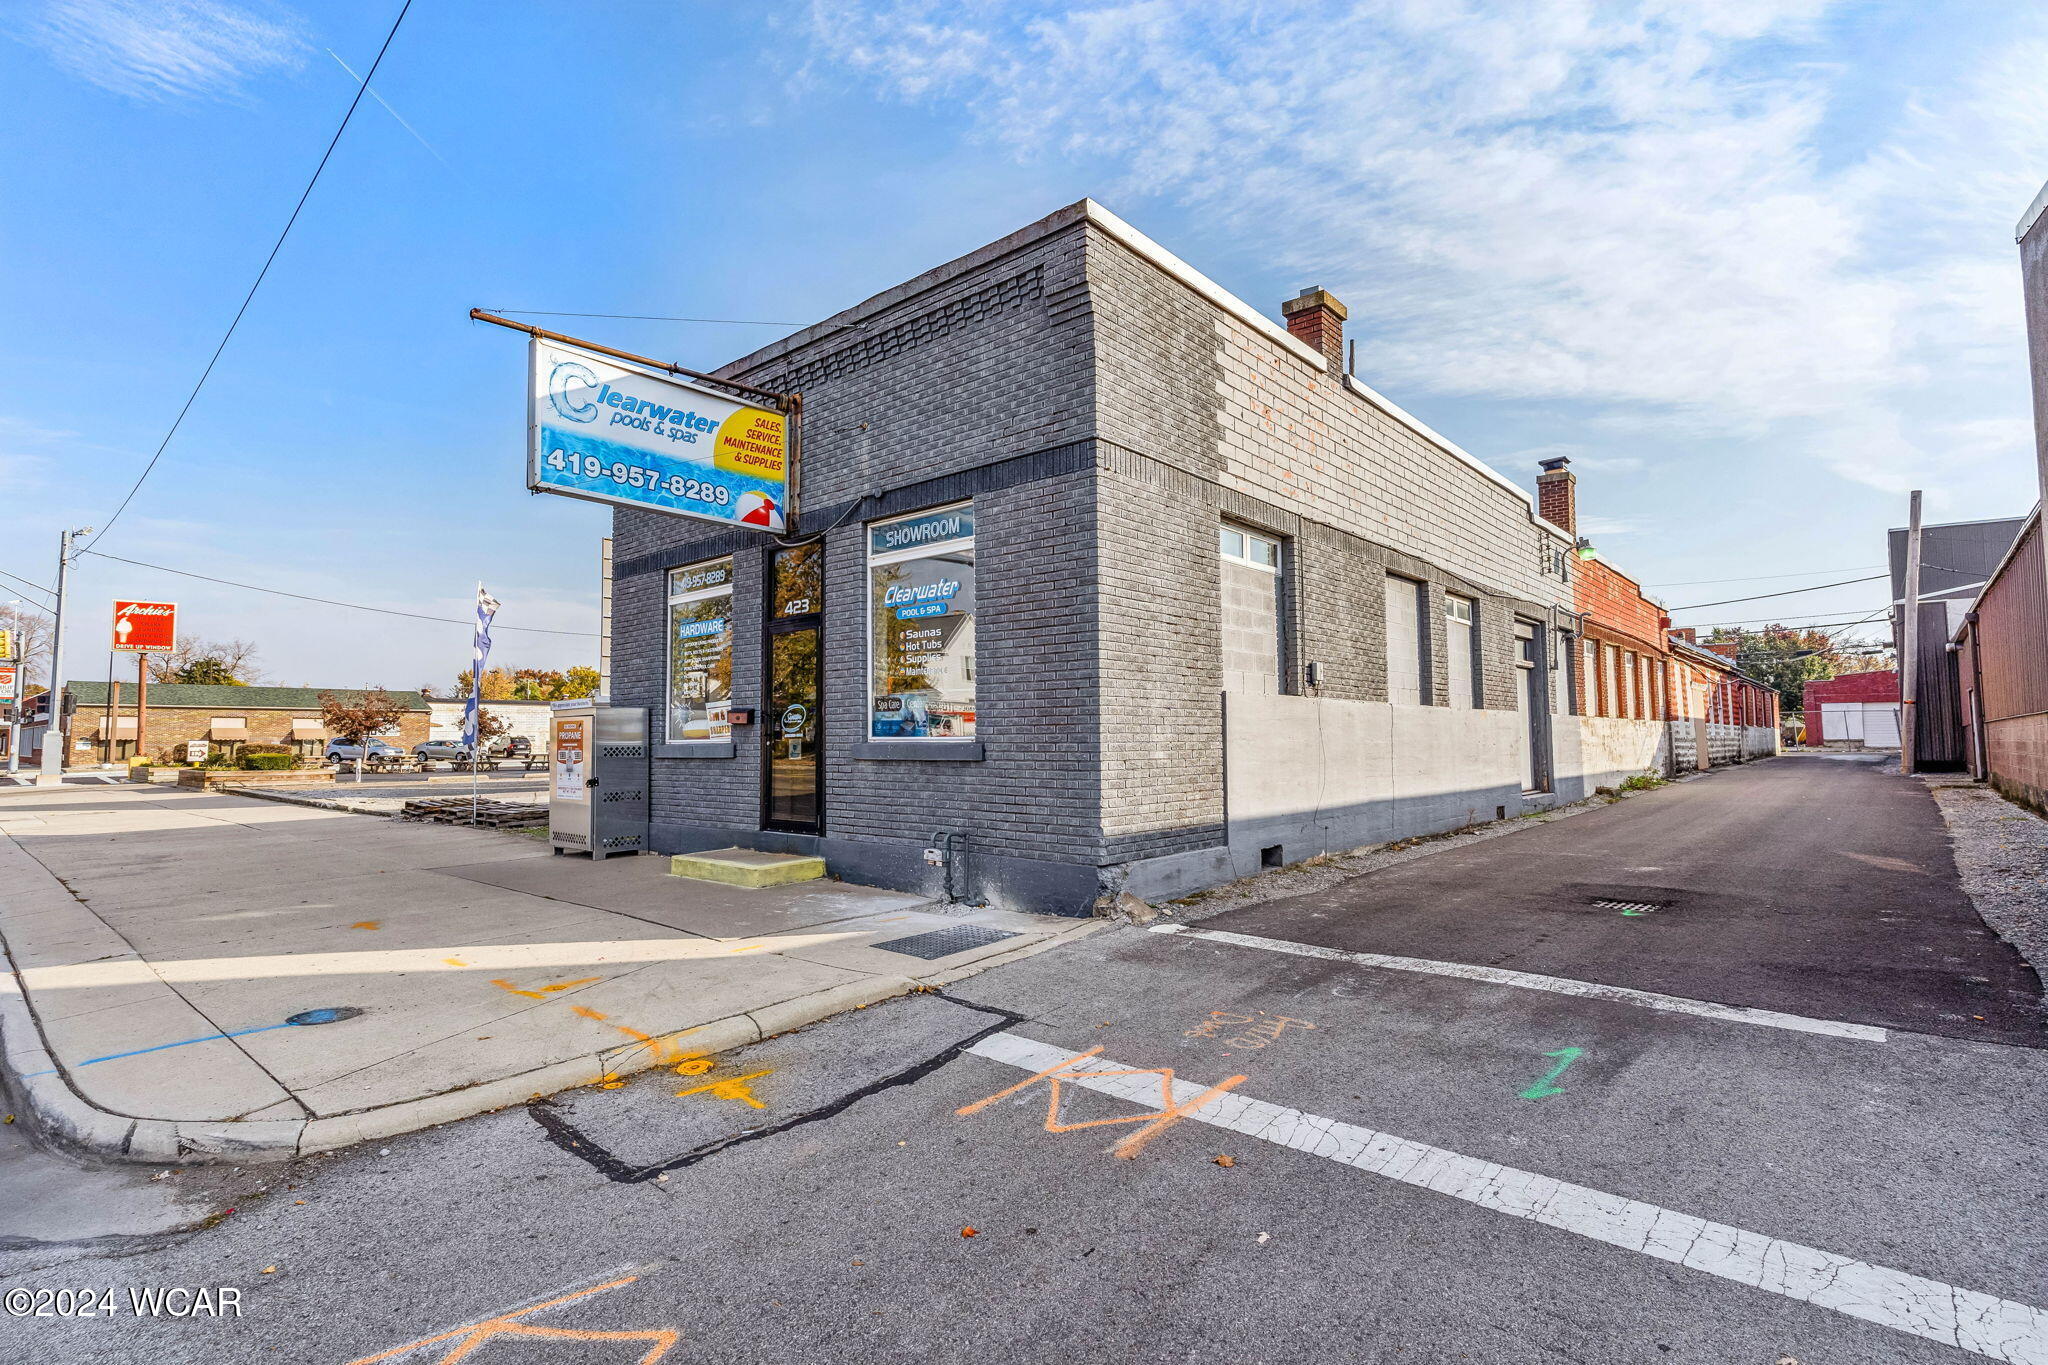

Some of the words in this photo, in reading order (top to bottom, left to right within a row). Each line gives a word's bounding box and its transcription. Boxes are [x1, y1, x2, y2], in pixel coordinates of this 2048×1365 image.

[549, 361, 720, 434] Clearwater
[610, 411, 652, 432] pools
[653, 420, 665, 435] &
[667, 427, 698, 444] spas
[723, 436, 782, 458] MAINTENANCE
[734, 452, 742, 462] &
[743, 454, 782, 470] SUPPLIES
[547, 449, 729, 505] 419-957-8289
[886, 517, 960, 547] SHOWROOM
[884, 579, 959, 605] Clearwater
[116, 604, 174, 616] Archie's
[785, 599, 809, 614] 423
[902, 609, 919, 617] POOL
[927, 605, 941, 613] SPA
[680, 620, 723, 636] HARDWARE
[906, 628, 941, 639] Saunas
[906, 642, 920, 651] Hot
[922, 640, 942, 649] Tubs
[906, 653, 942, 664] Supplies
[878, 700, 887, 711] Spa
[888, 699, 900, 709] Care
[559, 732, 582, 740] PROPANE
